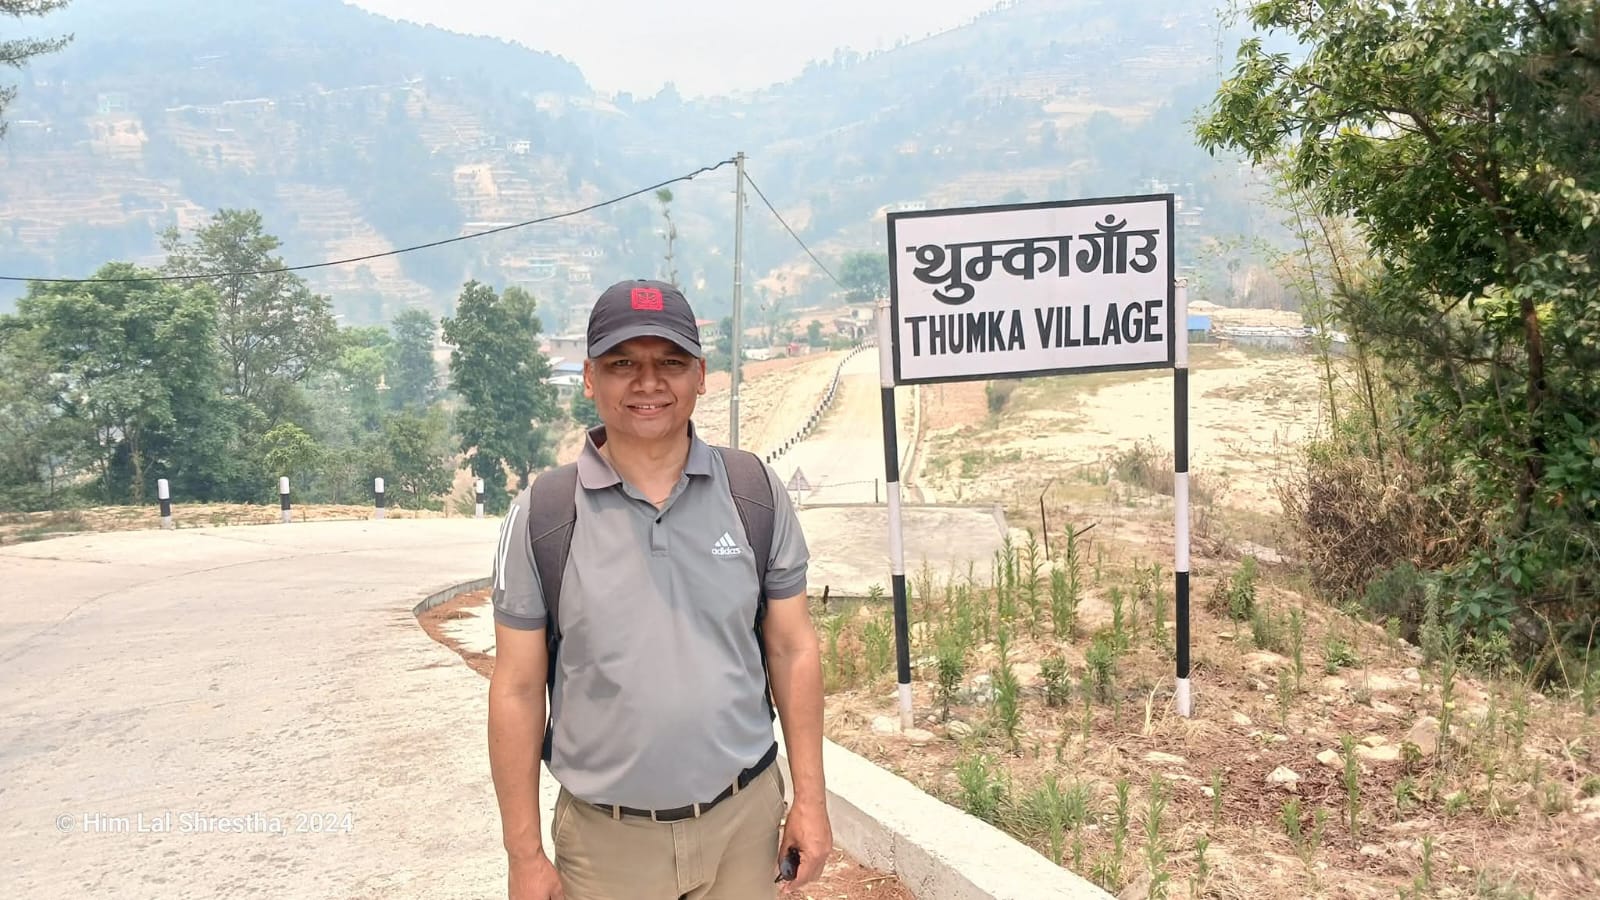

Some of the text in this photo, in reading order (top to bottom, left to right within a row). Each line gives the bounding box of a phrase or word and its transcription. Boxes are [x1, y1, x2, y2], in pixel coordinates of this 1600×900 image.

[904, 299, 1163, 357] THUMKA VILLAGE
[711, 546, 741, 555] adidas
